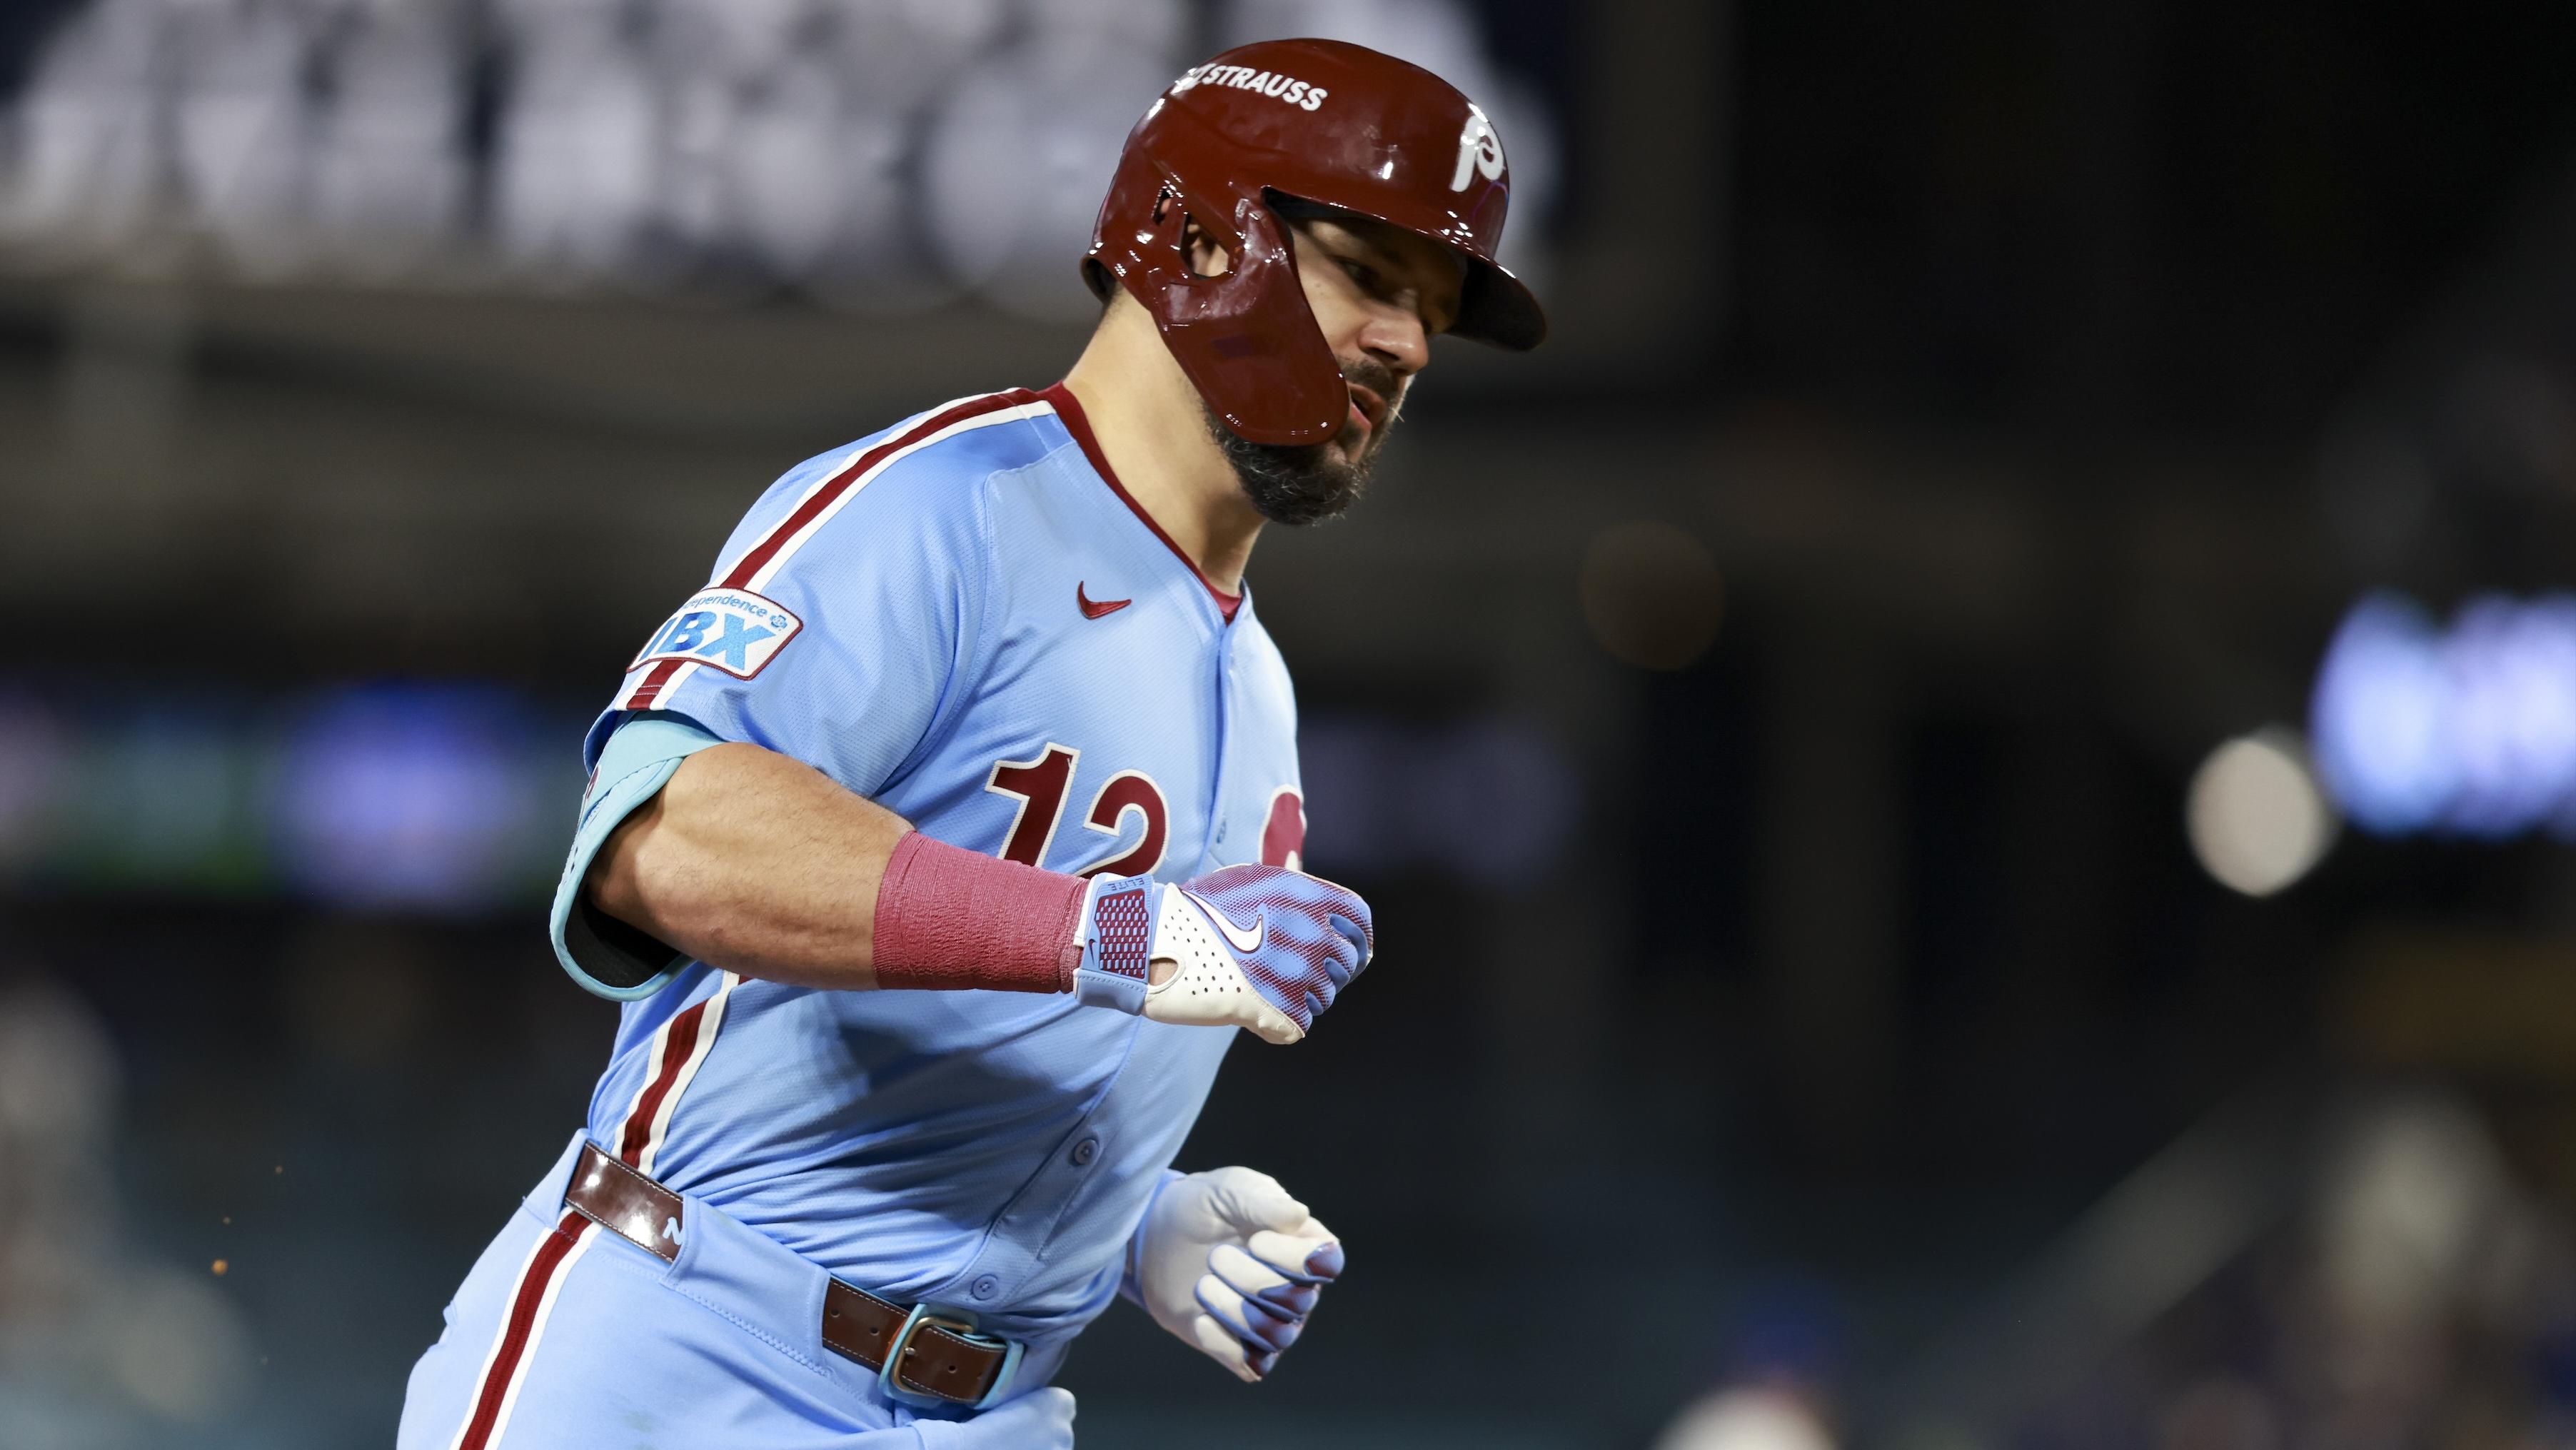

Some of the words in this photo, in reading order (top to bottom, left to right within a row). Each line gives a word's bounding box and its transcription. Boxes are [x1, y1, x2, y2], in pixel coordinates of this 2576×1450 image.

[1202, 65, 1328, 111] STRAUSS
[683, 595, 768, 616] dependence
[638, 611, 776, 670] IBX
[985, 742, 1170, 879] 12
[1107, 877, 1145, 891] ELITE
